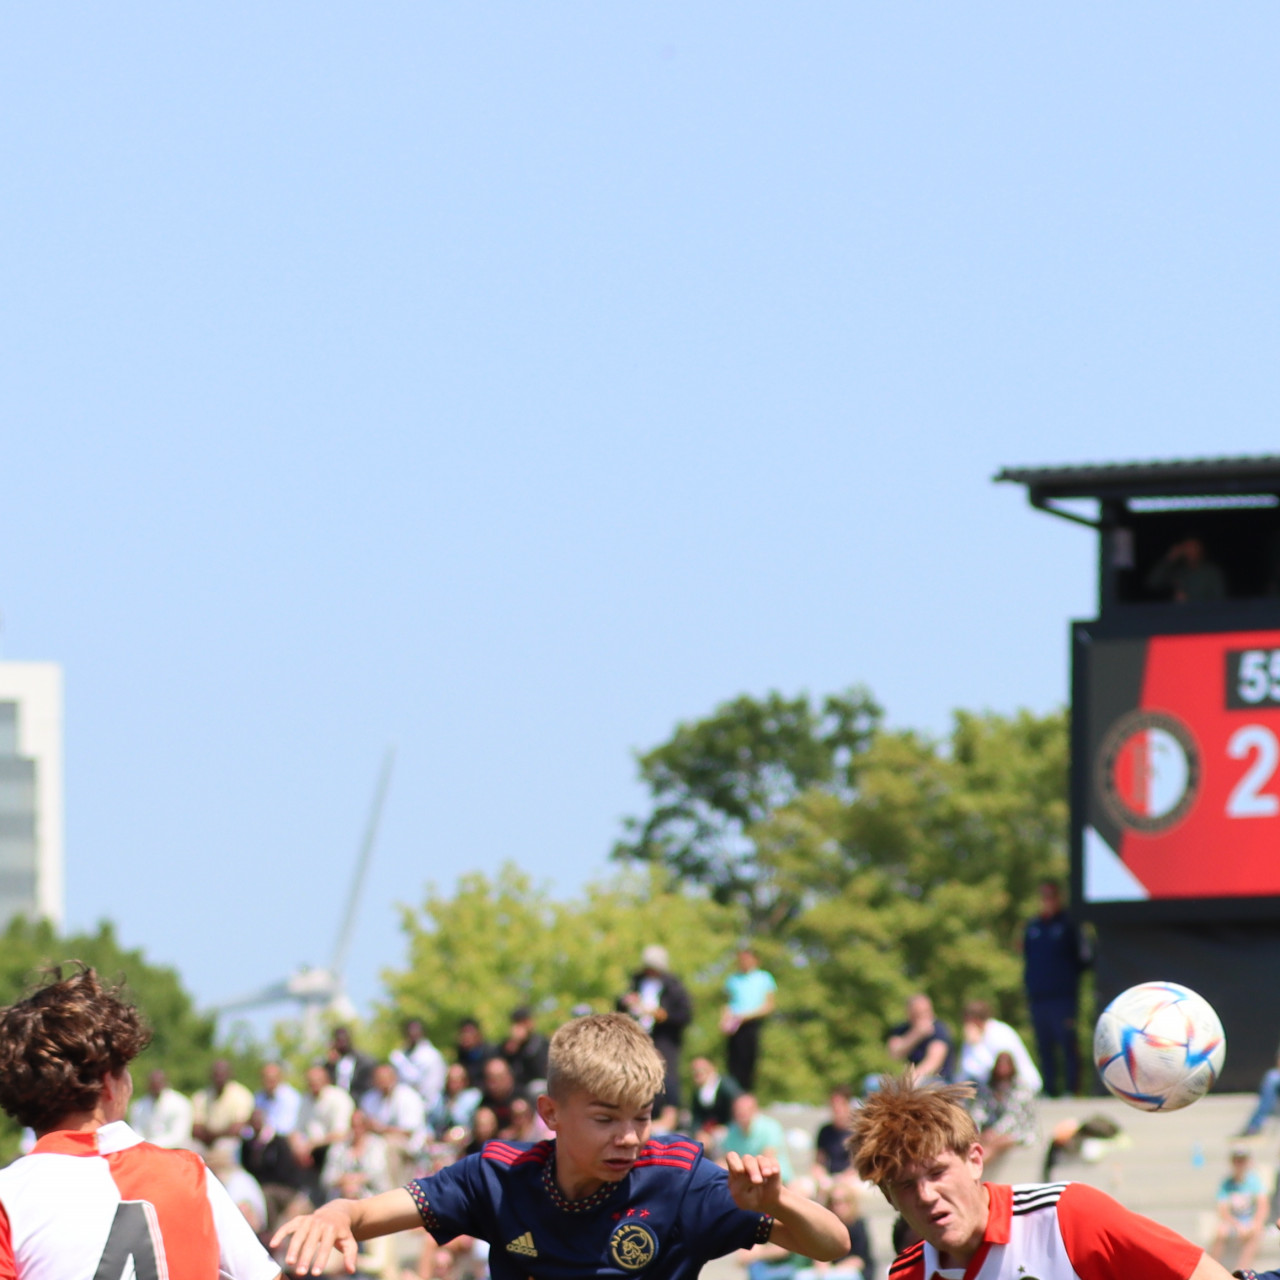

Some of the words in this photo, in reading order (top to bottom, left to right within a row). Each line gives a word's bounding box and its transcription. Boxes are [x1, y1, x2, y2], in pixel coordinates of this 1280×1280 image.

[1225, 723, 1280, 819] 2
[610, 1224, 631, 1248] AJAX
[506, 1243, 538, 1258] adidas
